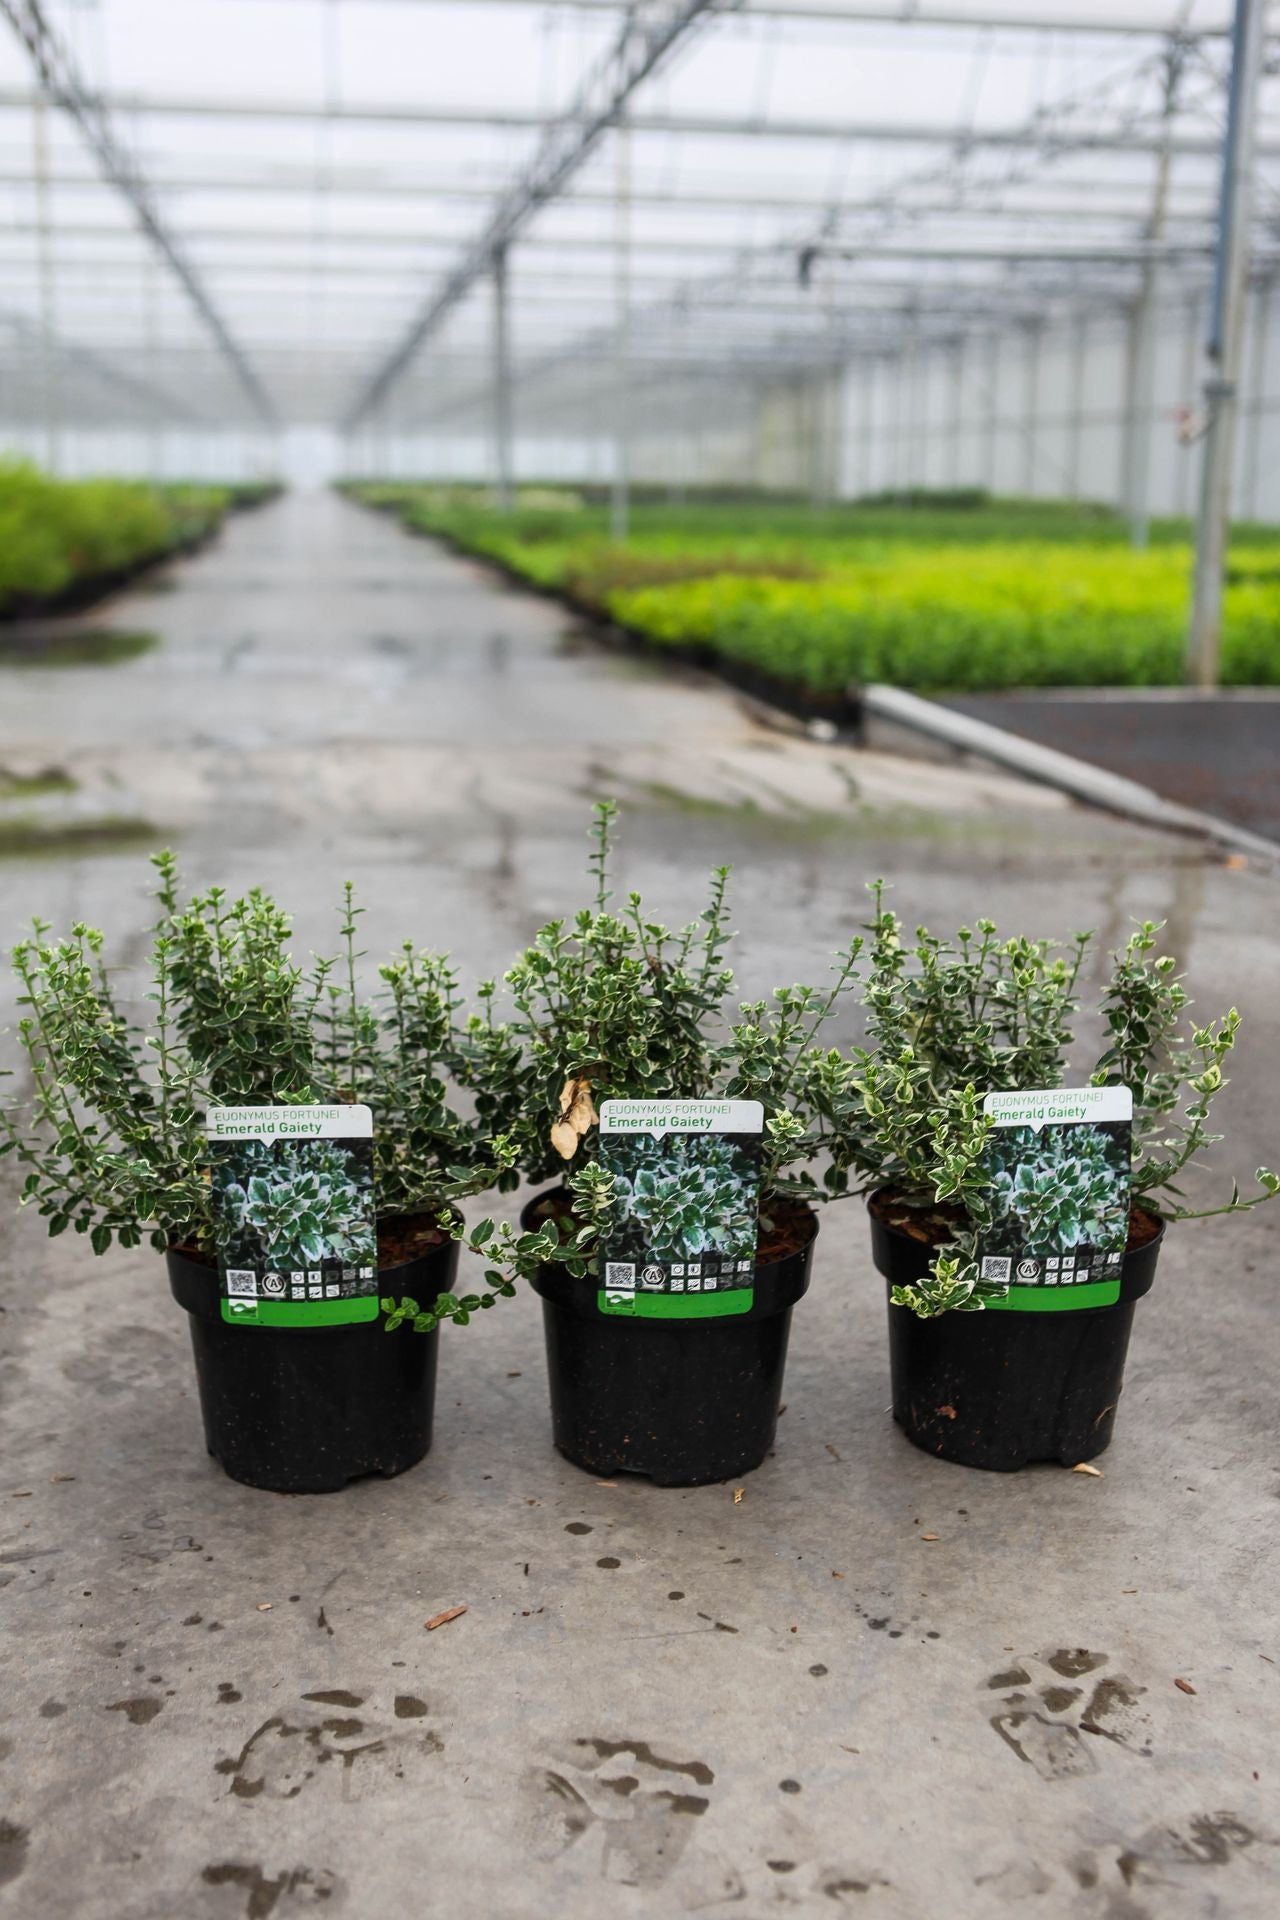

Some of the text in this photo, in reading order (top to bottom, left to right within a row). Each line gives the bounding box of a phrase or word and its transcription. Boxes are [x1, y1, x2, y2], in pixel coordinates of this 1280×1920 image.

[992, 1092, 1104, 1108] EUONYMUS FORTUNEI
[214, 1109, 340, 1122] EUONYMUS FORTUNEI
[608, 1105, 731, 1114] EUONYMUS FORTUNEI
[992, 1106, 1087, 1121] Emerald Gaiety
[216, 1121, 322, 1135] Emerald Gaiety
[608, 1116, 713, 1129] Emerald Gaiety
